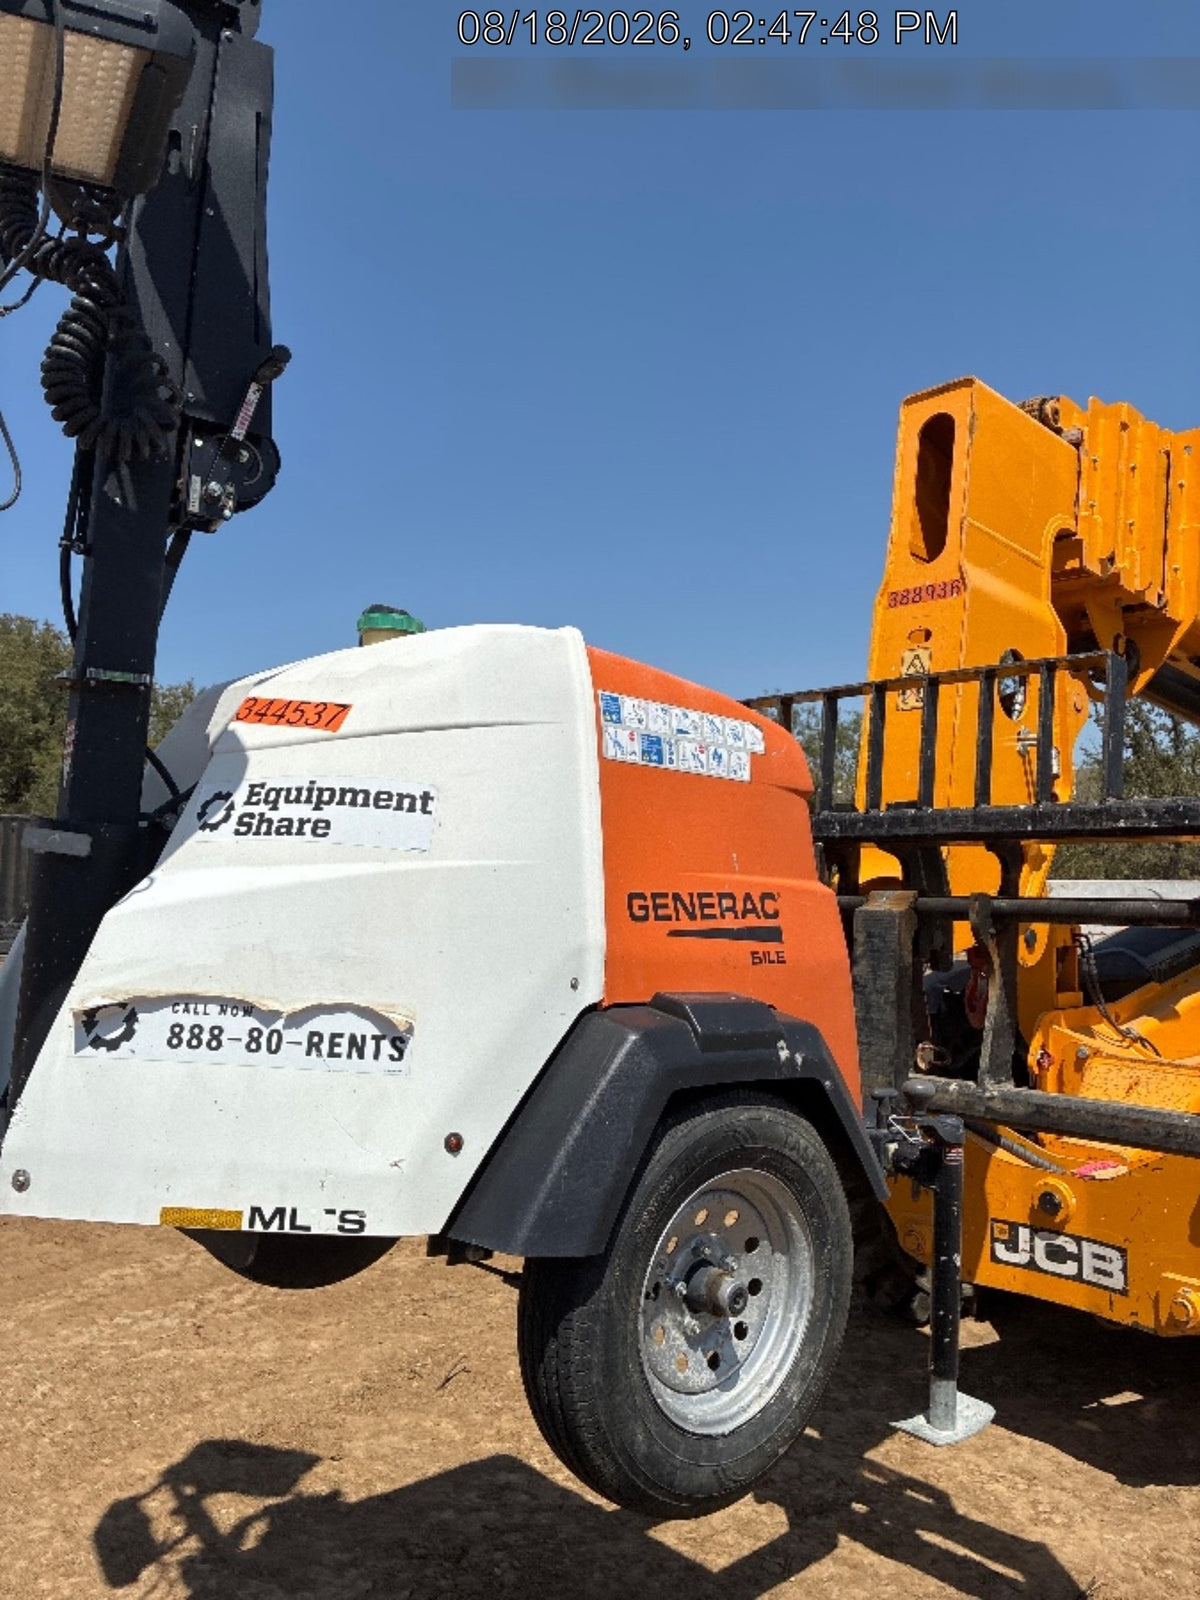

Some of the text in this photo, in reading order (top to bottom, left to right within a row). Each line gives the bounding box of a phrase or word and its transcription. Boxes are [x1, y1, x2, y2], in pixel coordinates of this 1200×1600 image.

[236, 697, 352, 728] 344537
[243, 780, 435, 815] Equipment
[234, 812, 332, 838] Share
[627, 892, 780, 922] GENERAC
[171, 1002, 255, 1018] CALL NOW
[166, 1023, 407, 1063] 888-80-RENTS
[248, 1205, 367, 1235] MLS
[993, 1226, 1126, 1291] JCB
